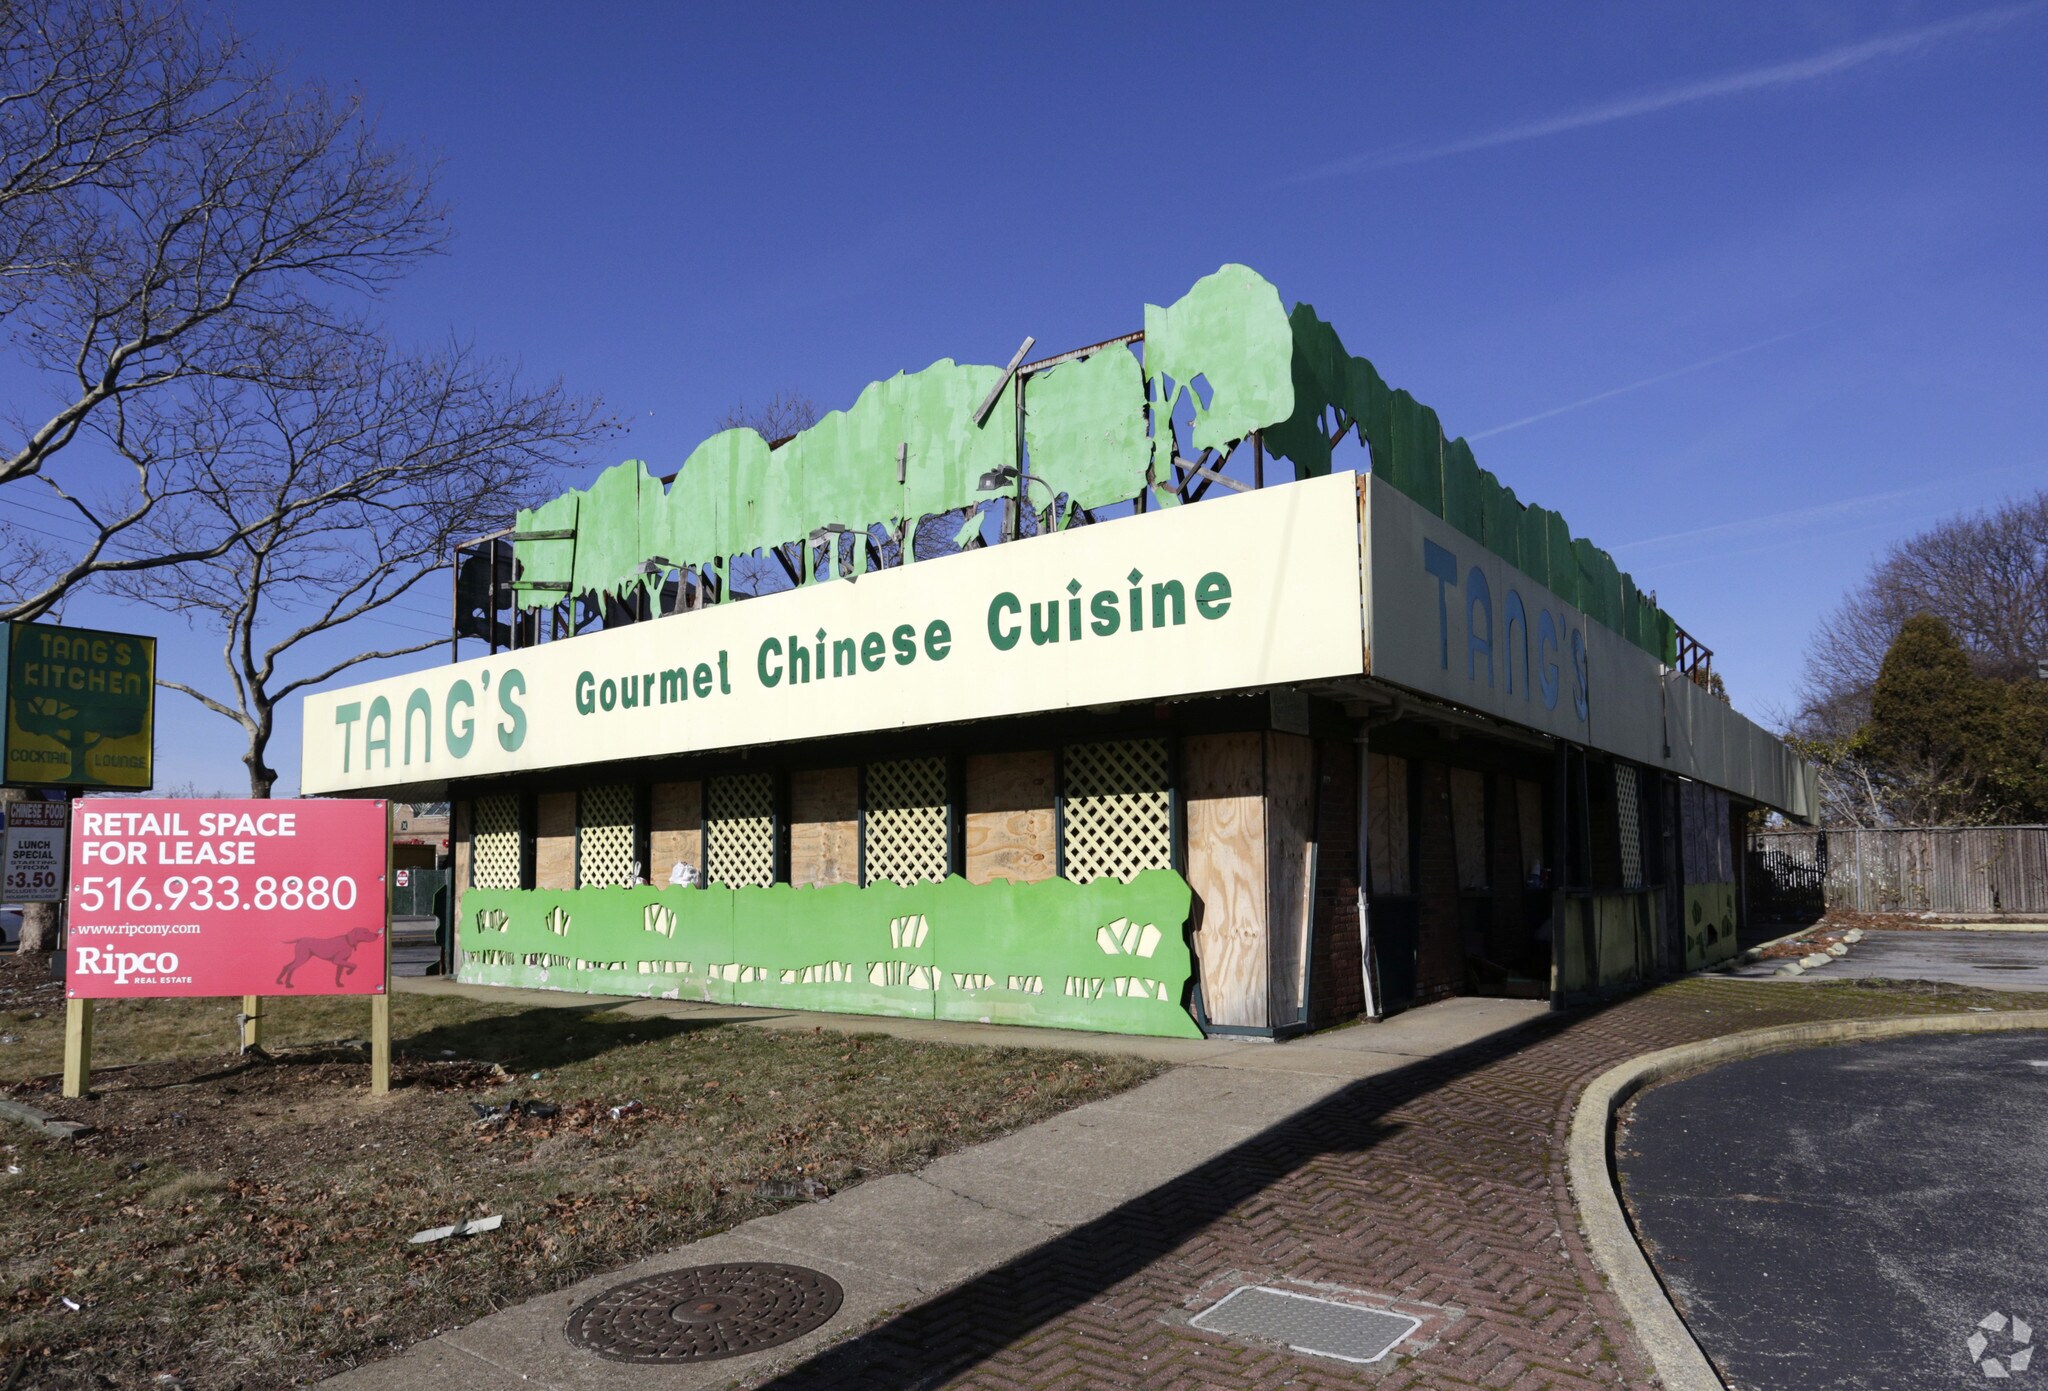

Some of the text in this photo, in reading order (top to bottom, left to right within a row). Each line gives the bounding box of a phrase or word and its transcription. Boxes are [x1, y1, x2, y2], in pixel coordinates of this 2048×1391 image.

[1423, 537, 1588, 722] TANG'S
[40, 633, 132, 666] TANG'S
[24, 662, 141, 696] KITCHEN
[336, 567, 1232, 774] TANG'S Gourmet Chinese Cuisine
[11, 749, 146, 768] COCKTAIL LOUNGE
[11, 803, 65, 819] CHINESE FOOD
[82, 812, 296, 837] RETAIL SPACE
[13, 850, 53, 859] SPECIAL
[19, 841, 50, 849] LUNCH
[82, 840, 256, 866] FOR LEASE
[7, 871, 56, 888] $3.50
[78, 875, 357, 912] 516.933.8880
[77, 922, 201, 937] www.ripcony.com
[75, 944, 179, 985] Ripco
[160, 976, 192, 984] ESTATE
